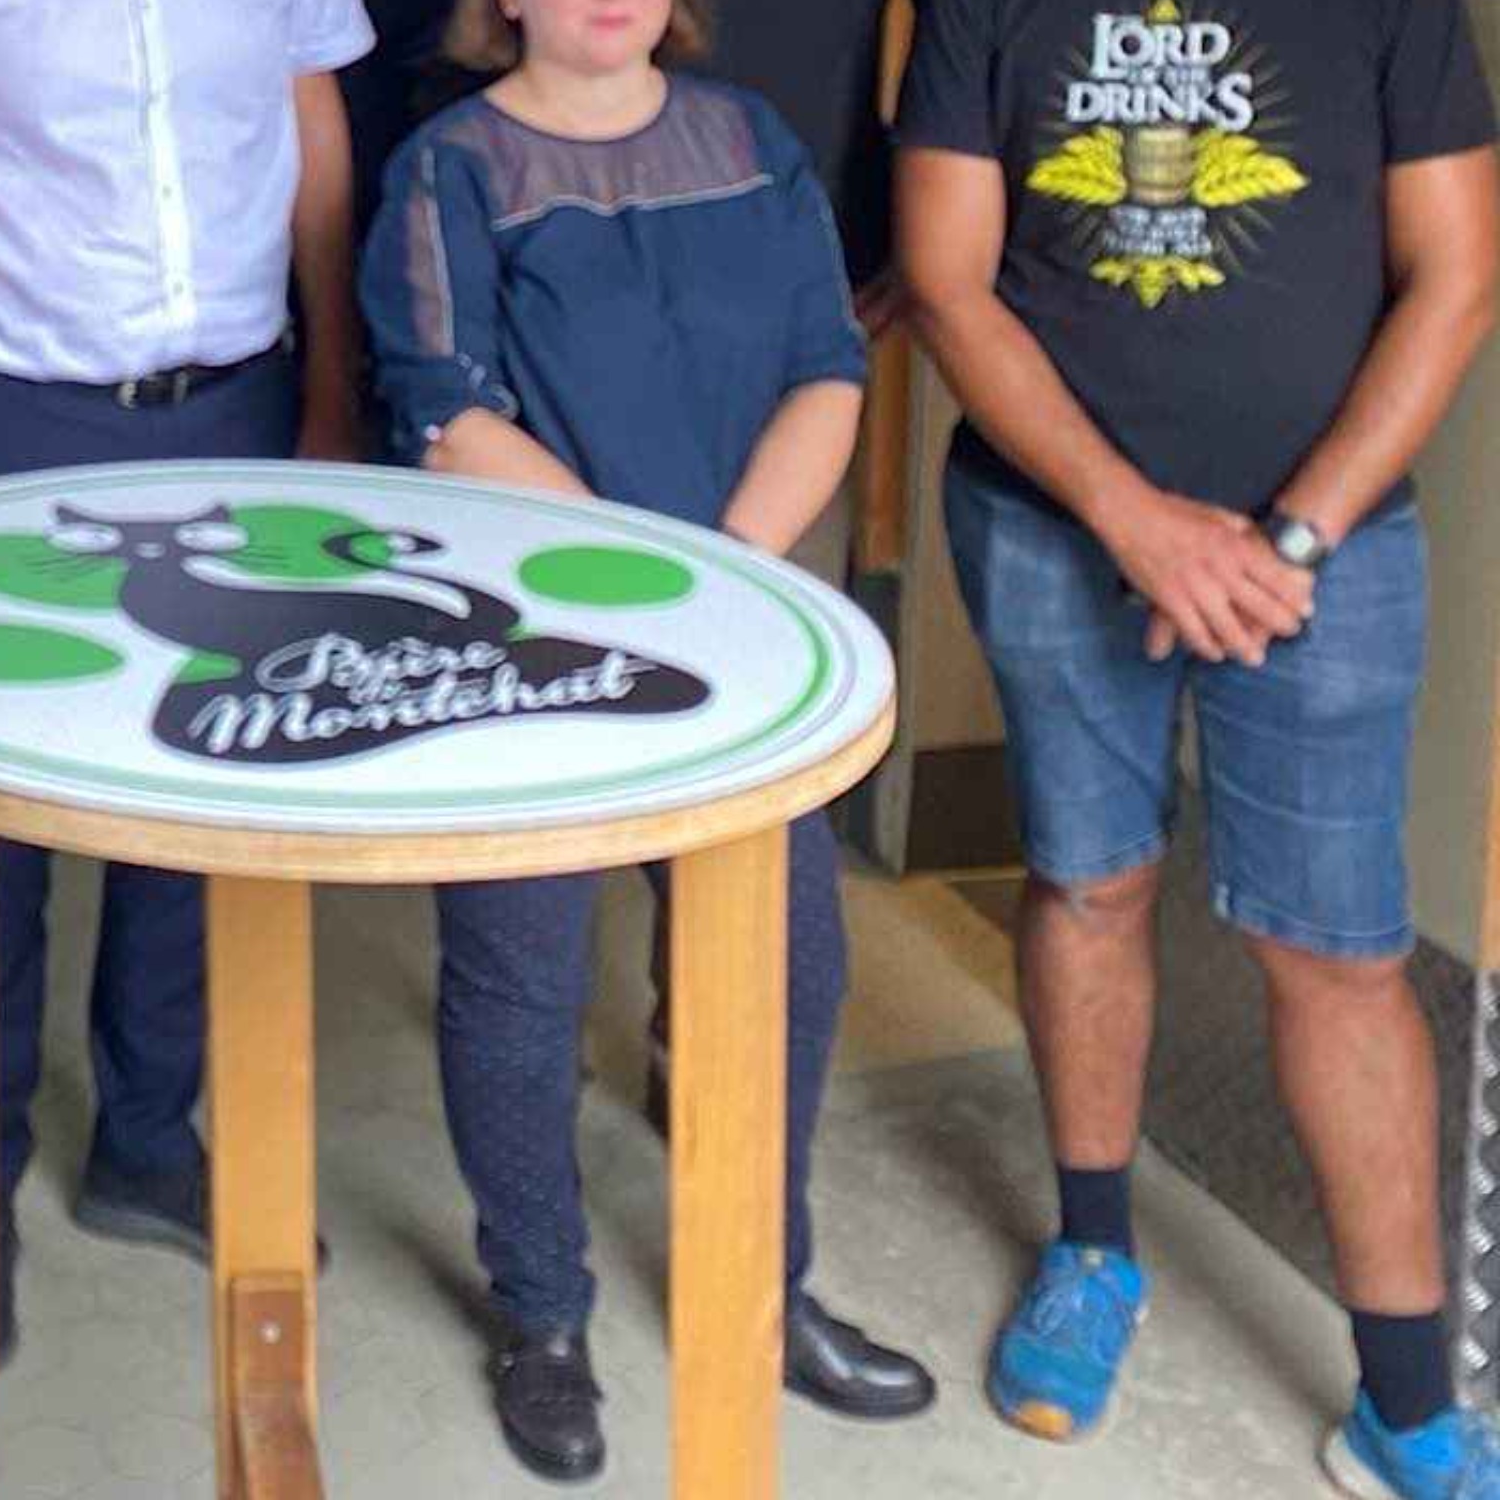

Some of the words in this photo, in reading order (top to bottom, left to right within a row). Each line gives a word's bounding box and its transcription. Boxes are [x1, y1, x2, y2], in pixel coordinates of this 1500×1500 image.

[1091, 12, 1231, 81] LORD
[1065, 72, 1254, 133] DRINKS
[187, 649, 659, 754] Montchat
